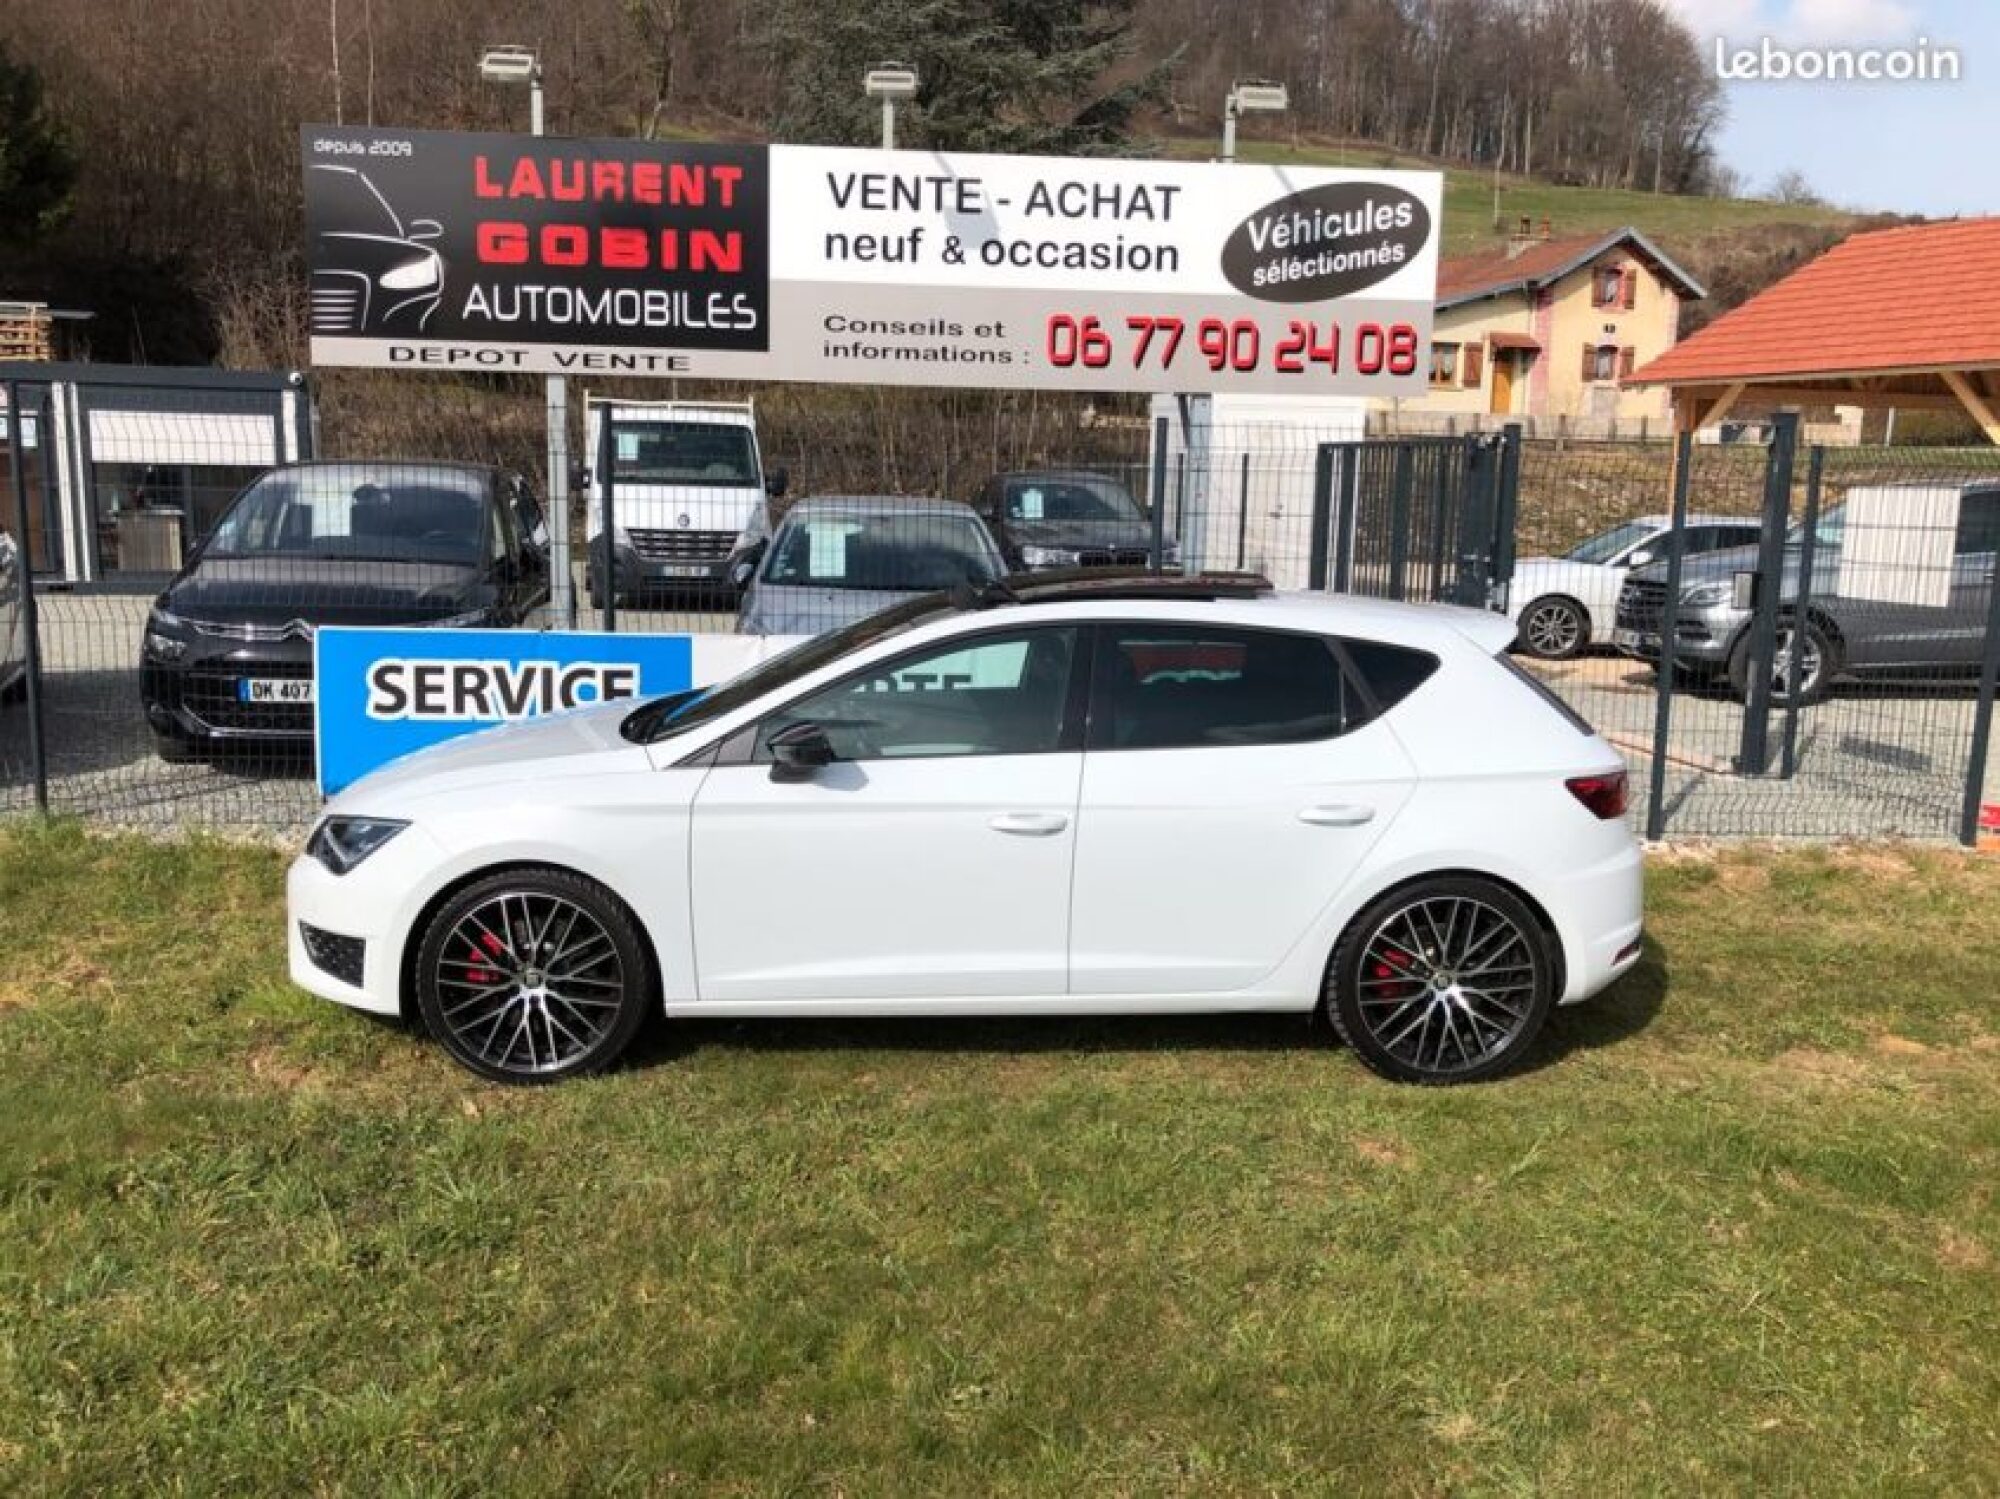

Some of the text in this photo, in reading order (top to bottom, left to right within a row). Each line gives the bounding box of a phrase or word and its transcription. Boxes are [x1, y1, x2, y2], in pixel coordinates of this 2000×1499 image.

[314, 139, 412, 156] depuis 2009
[474, 156, 743, 207] LAURENT
[827, 172, 982, 214] VENTE
[1025, 180, 1181, 220] ACHAT
[476, 222, 743, 272] GOBIN
[825, 227, 1179, 272] neuf & occasion
[1249, 200, 1412, 253] Véhicules
[1253, 240, 1405, 286] séléctionnés
[462, 284, 757, 330] AUTOMOBILES
[823, 315, 1005, 338] Conseils et
[389, 346, 690, 371] DEPOT VENTE
[824, 340, 1012, 364] informations
[1047, 314, 1418, 375] 06 77 90 24 08
